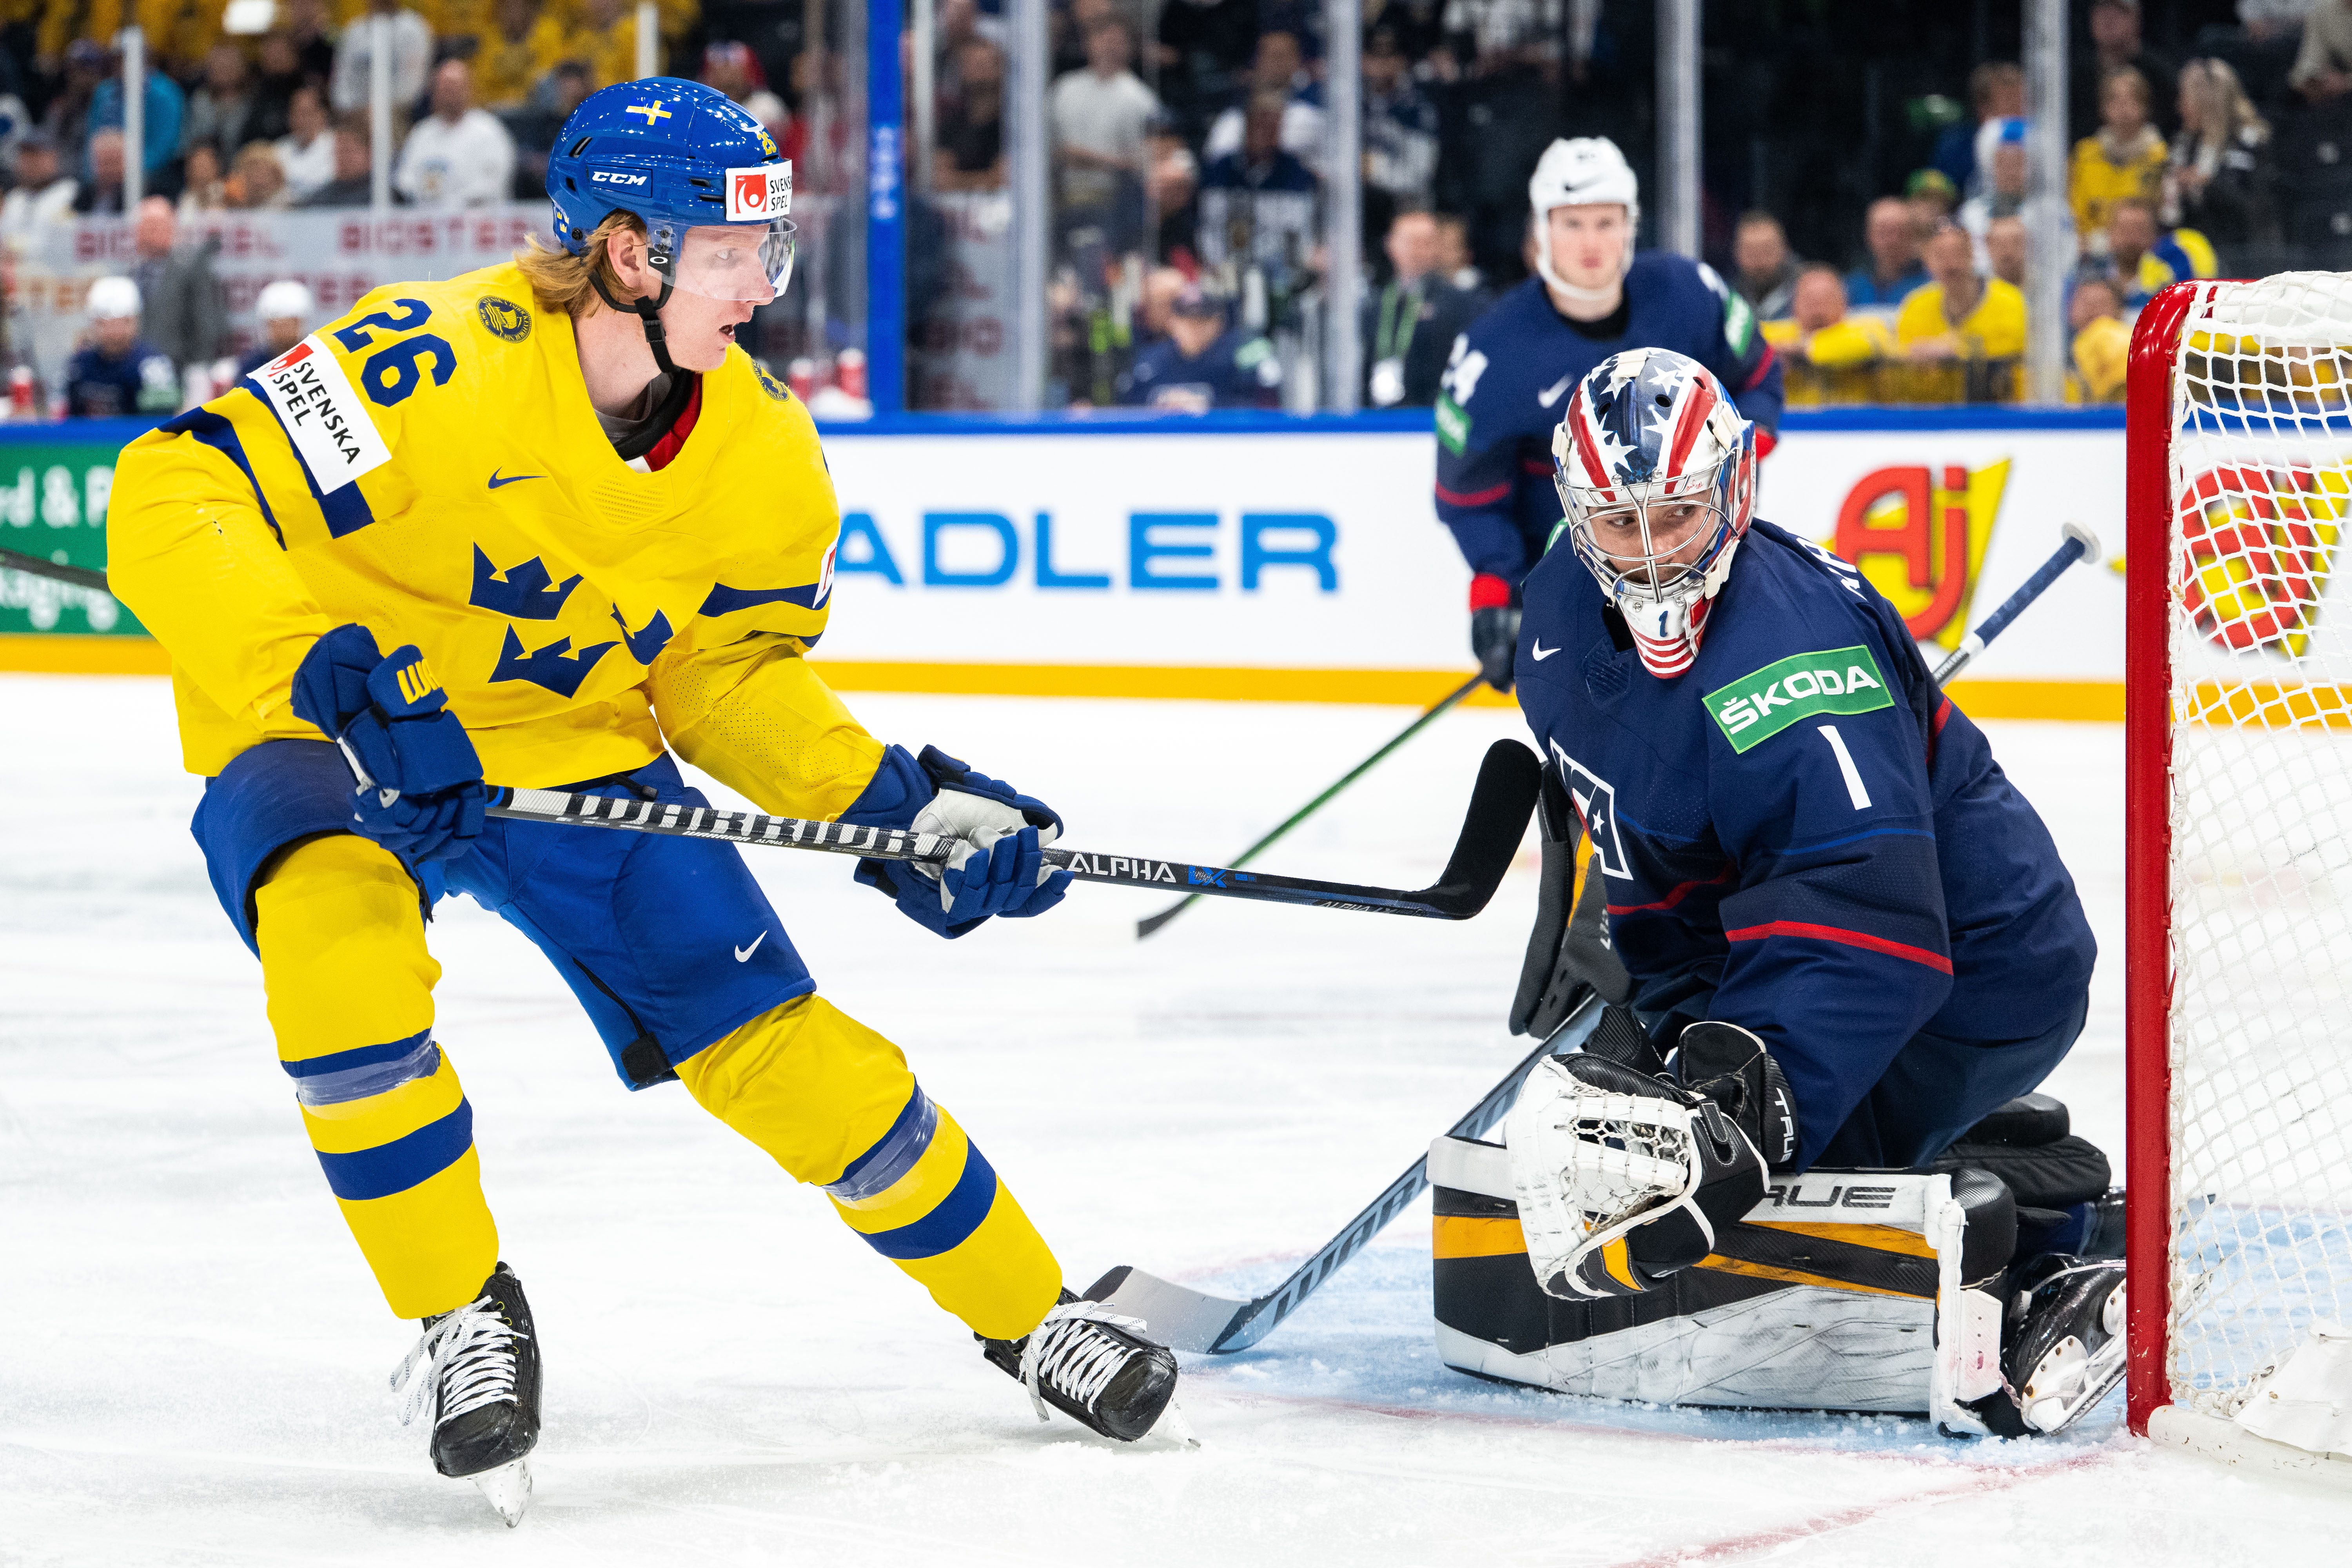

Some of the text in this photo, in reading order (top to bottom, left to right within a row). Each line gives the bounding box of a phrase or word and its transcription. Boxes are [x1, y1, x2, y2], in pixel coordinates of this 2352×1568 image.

[757, 131, 777, 155] 26
[592, 171, 647, 185] CCM
[771, 195, 788, 211] SPEL
[332, 298, 457, 408] 26
[272, 373, 311, 427] SPEL
[293, 362, 361, 465] SVENSKA
[834, 512, 1338, 590] ADLER
[1658, 610, 1669, 637] 1
[1719, 665, 1881, 735] ŠKODA
[1817, 725, 1872, 810] 1
[682, 831, 751, 842] WARRIOR
[1066, 853, 1176, 883] ALPHA
[1188, 865, 1227, 888] LX
